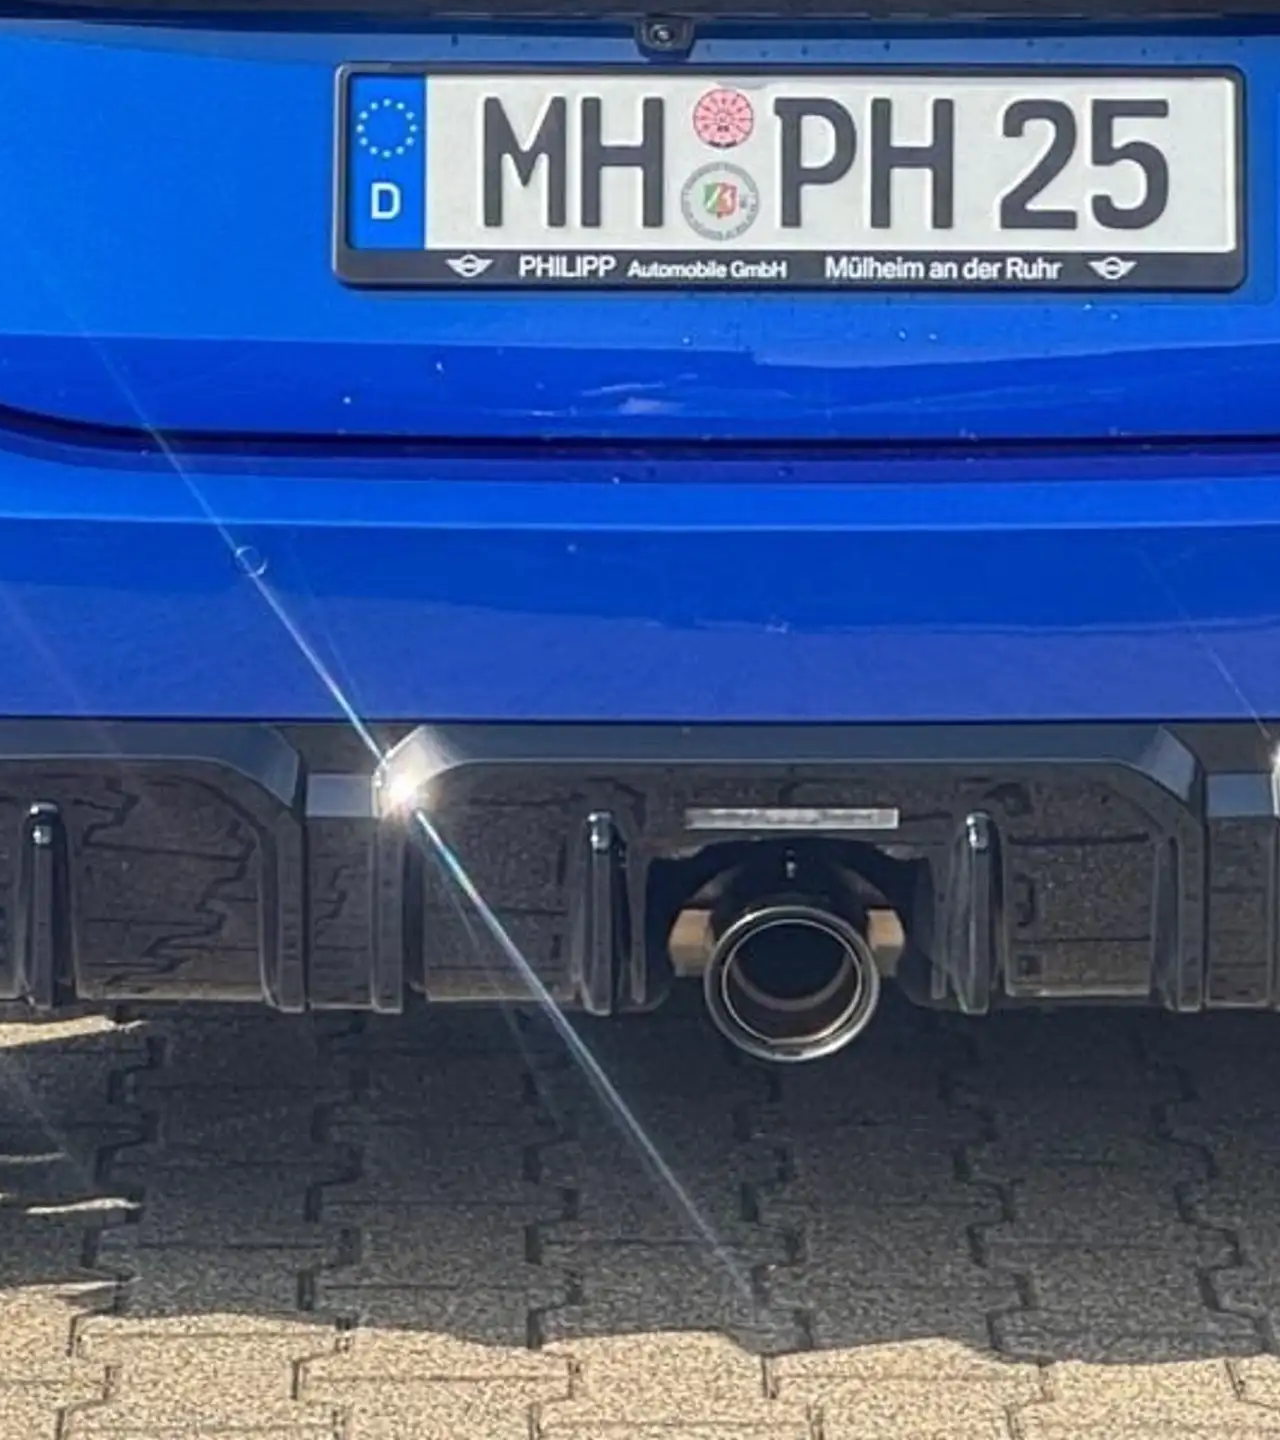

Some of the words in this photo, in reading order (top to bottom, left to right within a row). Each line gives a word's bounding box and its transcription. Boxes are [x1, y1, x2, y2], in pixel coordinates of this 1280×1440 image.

[483, 96, 665, 228] MH
[774, 97, 954, 229] PH
[999, 99, 1170, 230] 25
[371, 182, 401, 219] D
[519, 254, 618, 278] PHILIPP
[627, 260, 728, 279] Automobile
[730, 260, 787, 278] GmbH
[824, 255, 926, 280] Mülheim
[928, 262, 959, 279] an
[962, 256, 1001, 280] der
[1006, 256, 1063, 280] Ruhr
